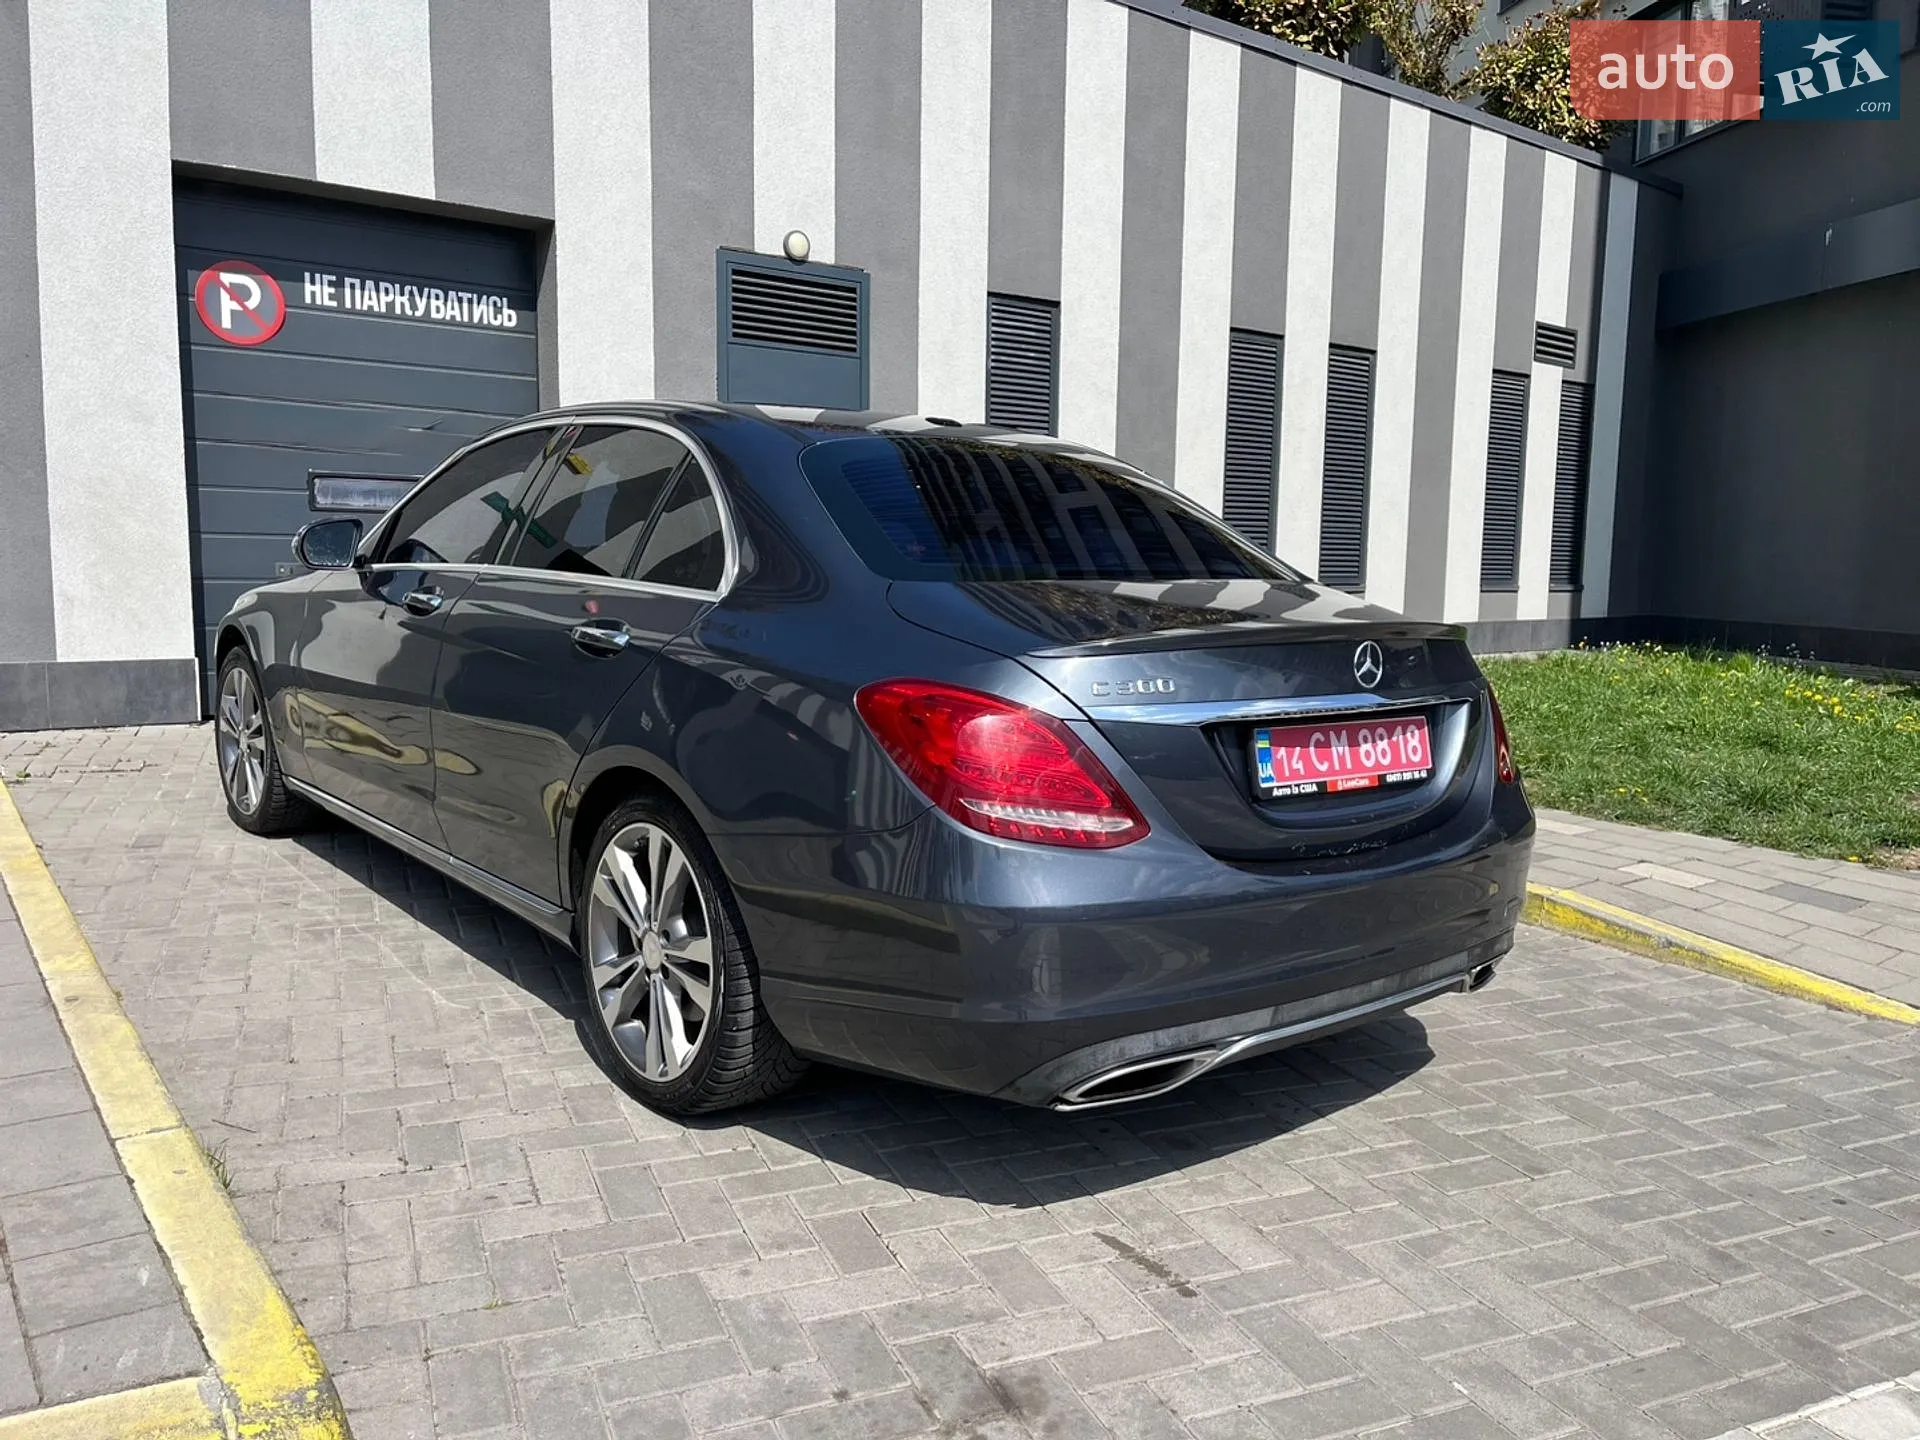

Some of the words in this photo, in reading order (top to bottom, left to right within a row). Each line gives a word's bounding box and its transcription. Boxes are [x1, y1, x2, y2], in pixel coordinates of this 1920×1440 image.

[303, 272, 337, 307] НЕ
[344, 277, 517, 327] ПАРКУВАТИСЬ
[1092, 681, 1110, 697] C
[1116, 677, 1176, 695] 300
[1276, 746, 1305, 777] 14
[1309, 729, 1352, 772] CM
[1358, 724, 1422, 768] 8818
[1259, 762, 1274, 778] UA
